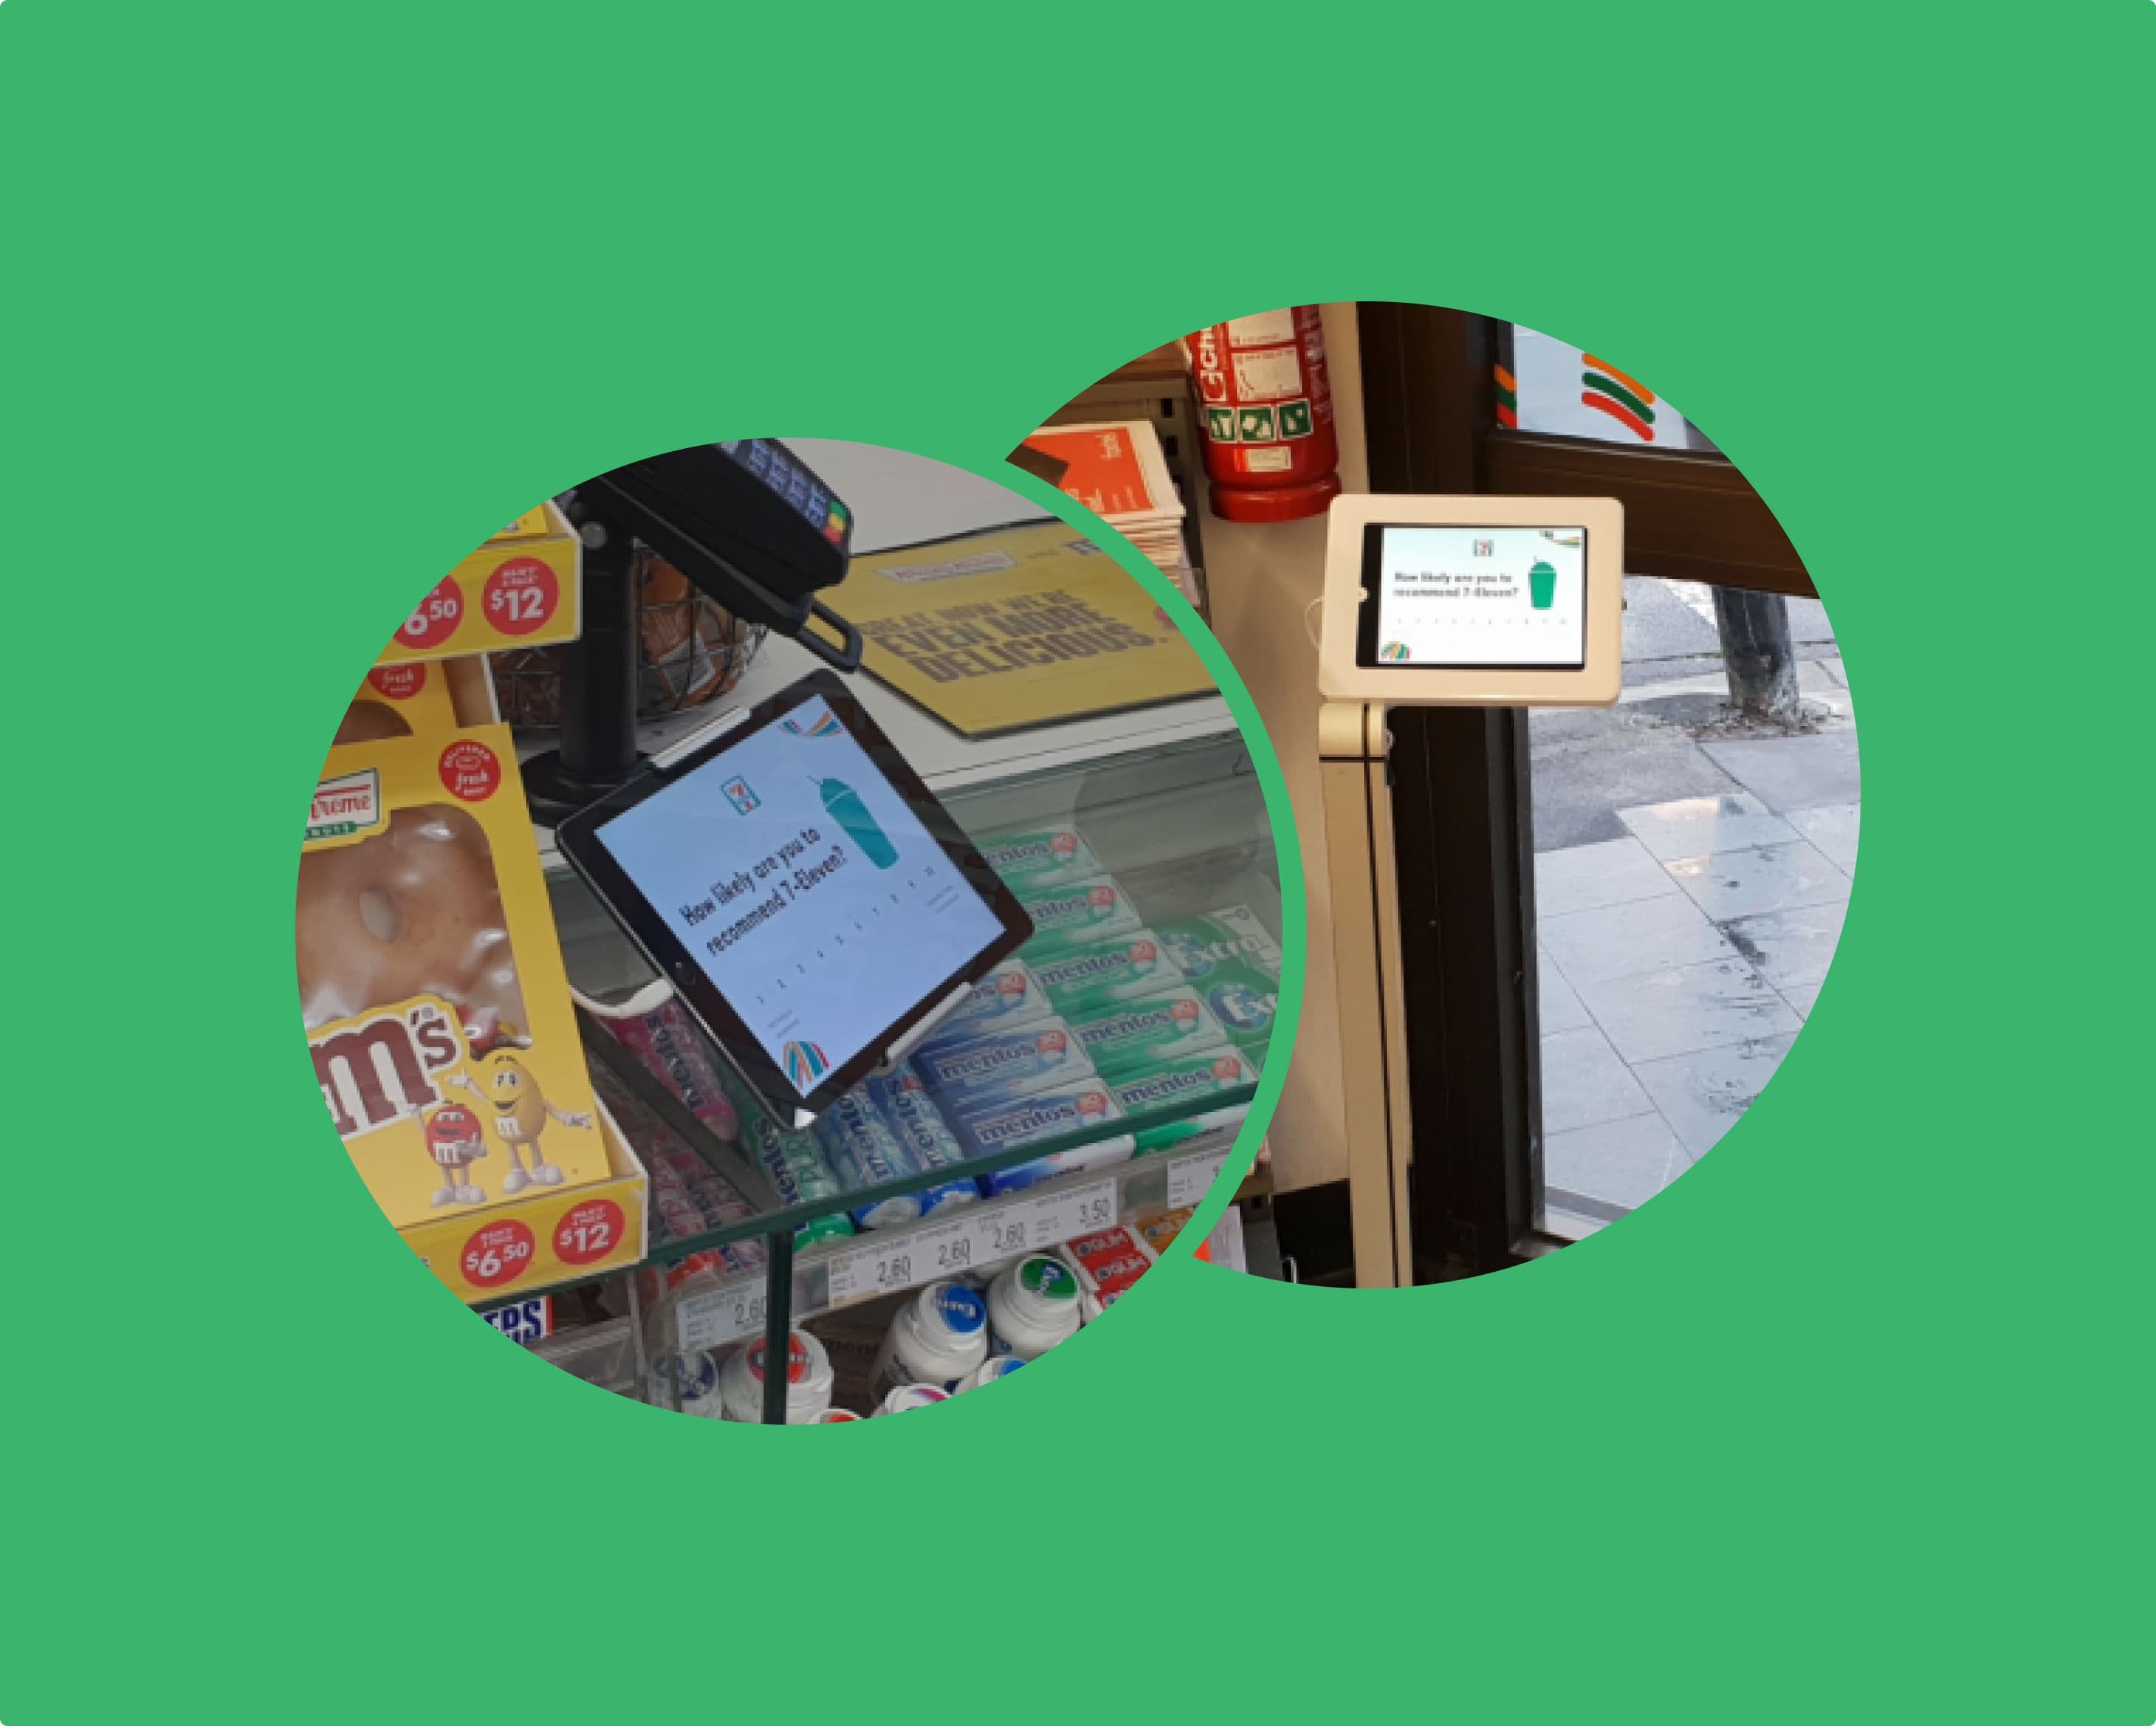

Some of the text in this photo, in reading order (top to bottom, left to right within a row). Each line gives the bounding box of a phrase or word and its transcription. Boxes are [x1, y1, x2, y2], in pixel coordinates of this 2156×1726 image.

[491, 585, 544, 622] $12
[871, 603, 1117, 658] EVEN MORE
[678, 827, 821, 926] How likely are you to
[706, 888, 787, 957] recommend
[780, 843, 849, 901] 7-Eleven?
[1039, 952, 1129, 986] mentos
[1080, 1011, 1172, 1045] mentos
[942, 1042, 1037, 1080] mentos
[1121, 1070, 1213, 1105] mentos
[982, 1104, 1076, 1142] mentos
[559, 1222, 610, 1254] $12
